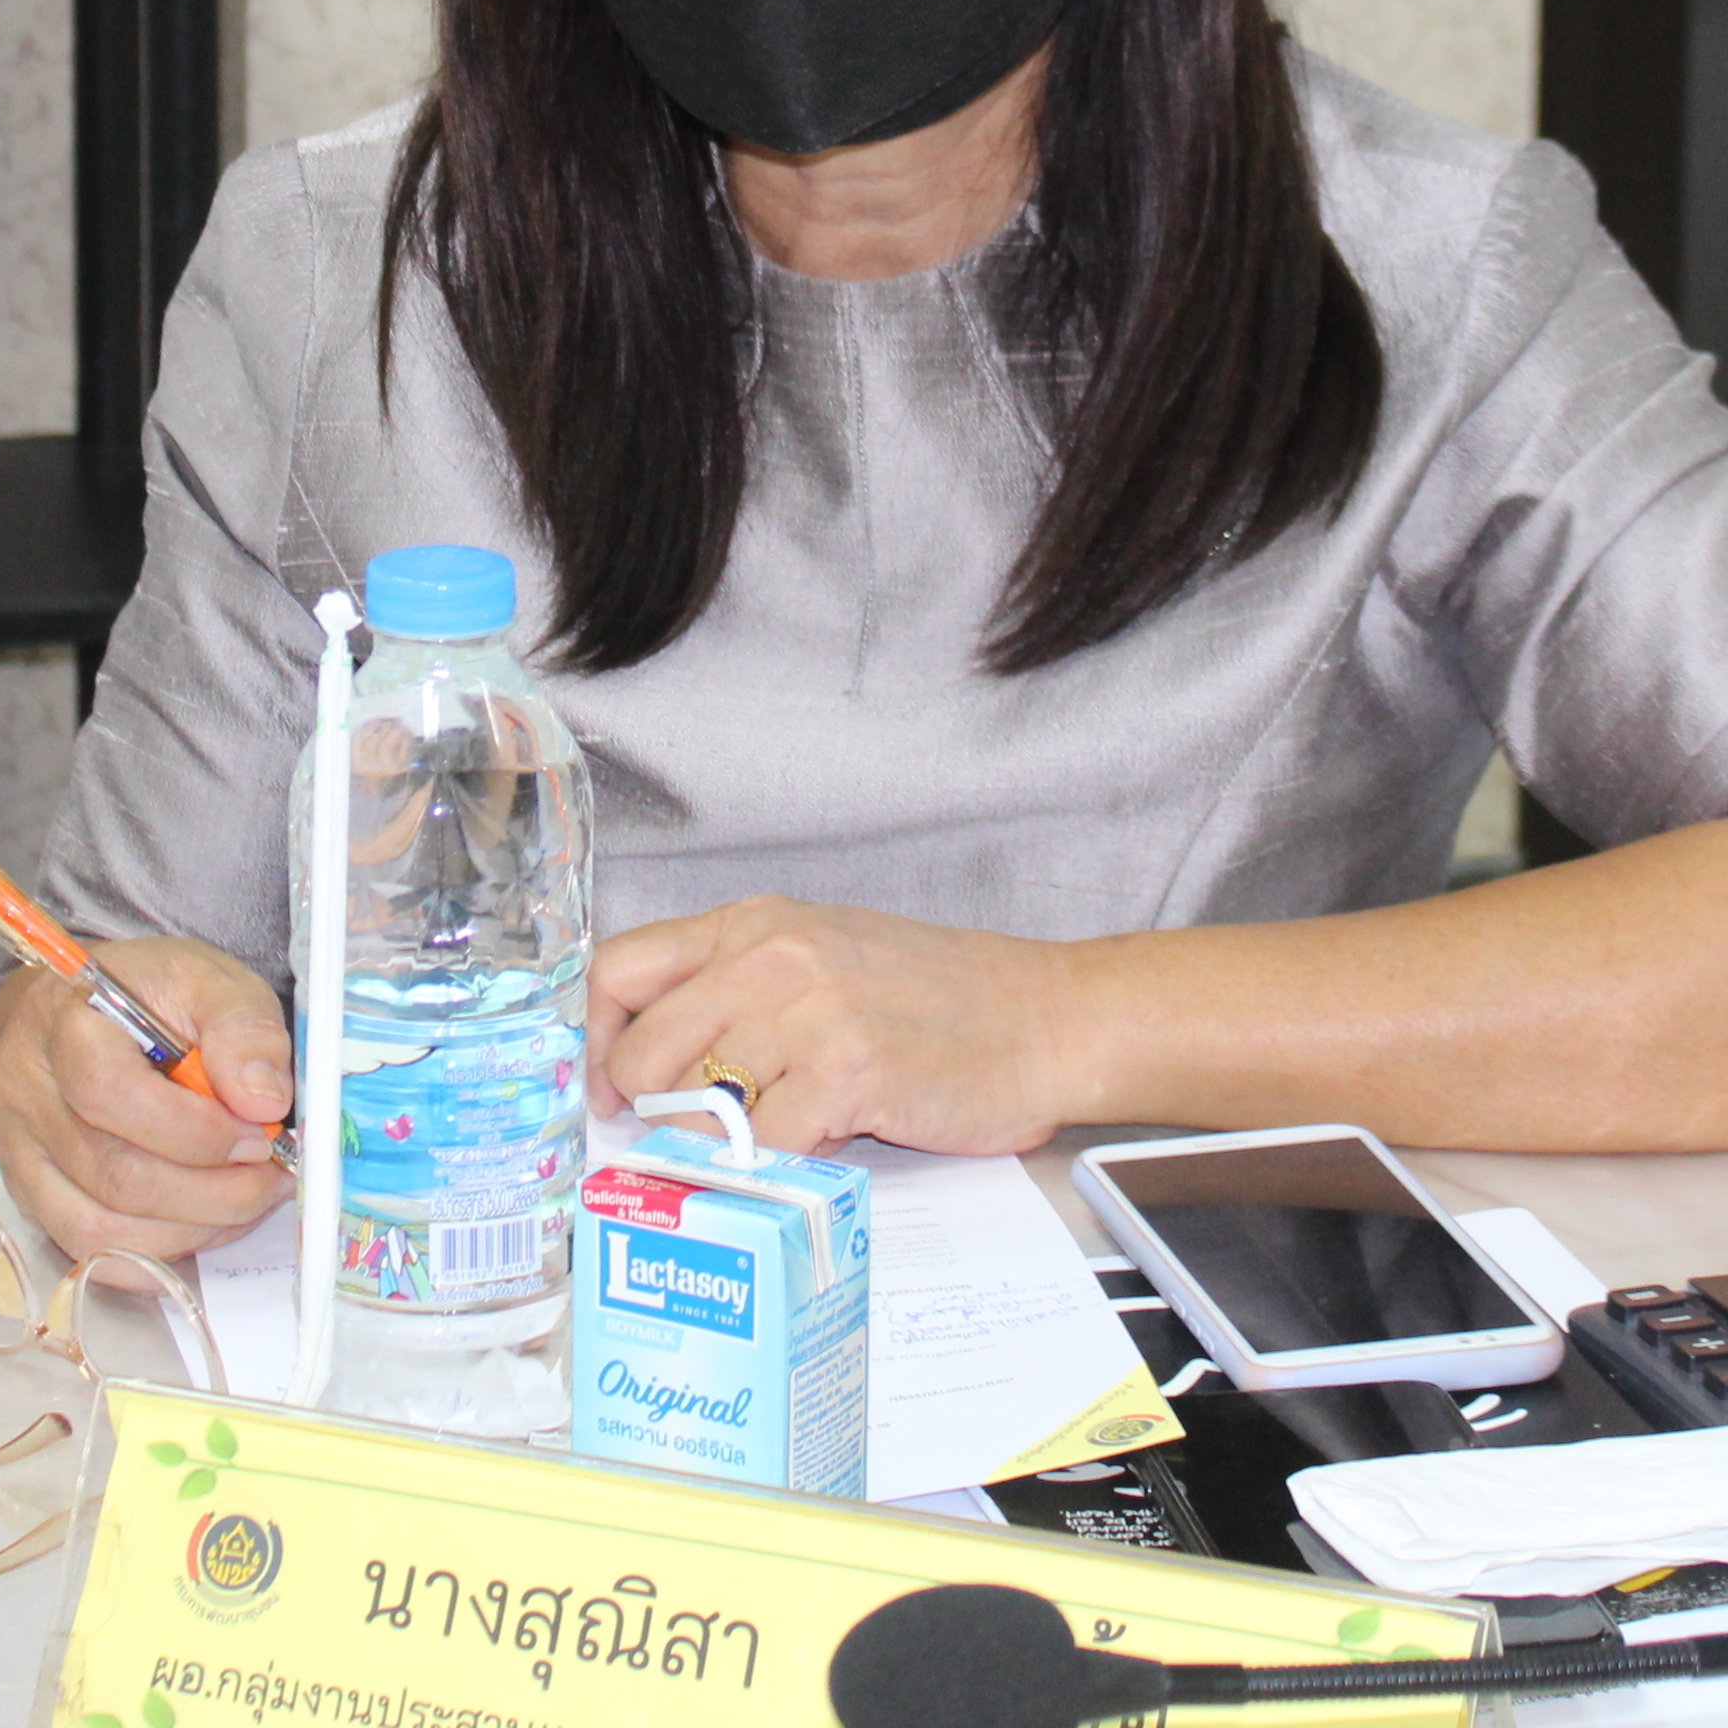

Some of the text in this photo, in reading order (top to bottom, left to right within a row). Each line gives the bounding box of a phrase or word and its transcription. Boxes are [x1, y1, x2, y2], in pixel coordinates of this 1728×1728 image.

[583, 1190, 643, 1208] Delicious
[617, 1207, 677, 1230] & Healthy
[605, 1230, 750, 1315] Lactasoy
[672, 1302, 709, 1320] SINCE
[604, 1317, 676, 1346] SOYMILK
[597, 1359, 754, 1429] Original
[597, 1416, 669, 1448] รสหวาน
[363, 1558, 760, 1691] นางสุณิสา
